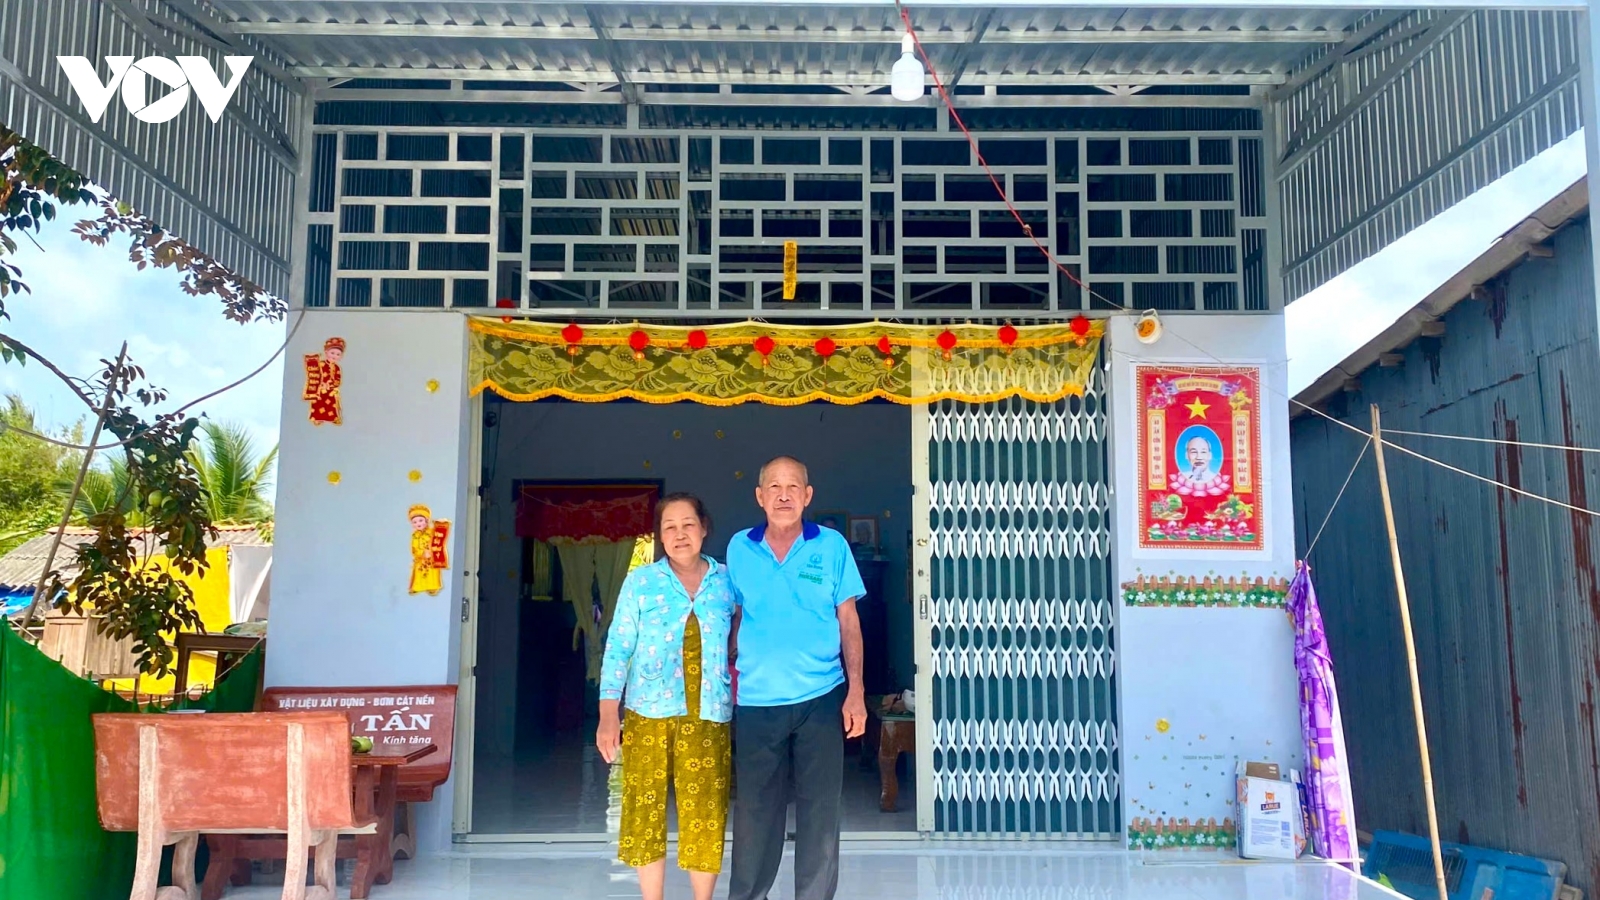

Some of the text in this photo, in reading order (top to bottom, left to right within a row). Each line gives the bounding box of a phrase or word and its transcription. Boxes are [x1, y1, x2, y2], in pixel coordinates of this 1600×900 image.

[279, 698, 297, 709] VẬT
[298, 697, 318, 709] LIỆU
[320, 697, 339, 708] XÂY
[340, 698, 365, 709] DỰNG
[373, 697, 394, 706] BƠM
[396, 695, 414, 706] CÁT
[360, 706, 434, 732] TẤN
[383, 736, 406, 744] Kính
